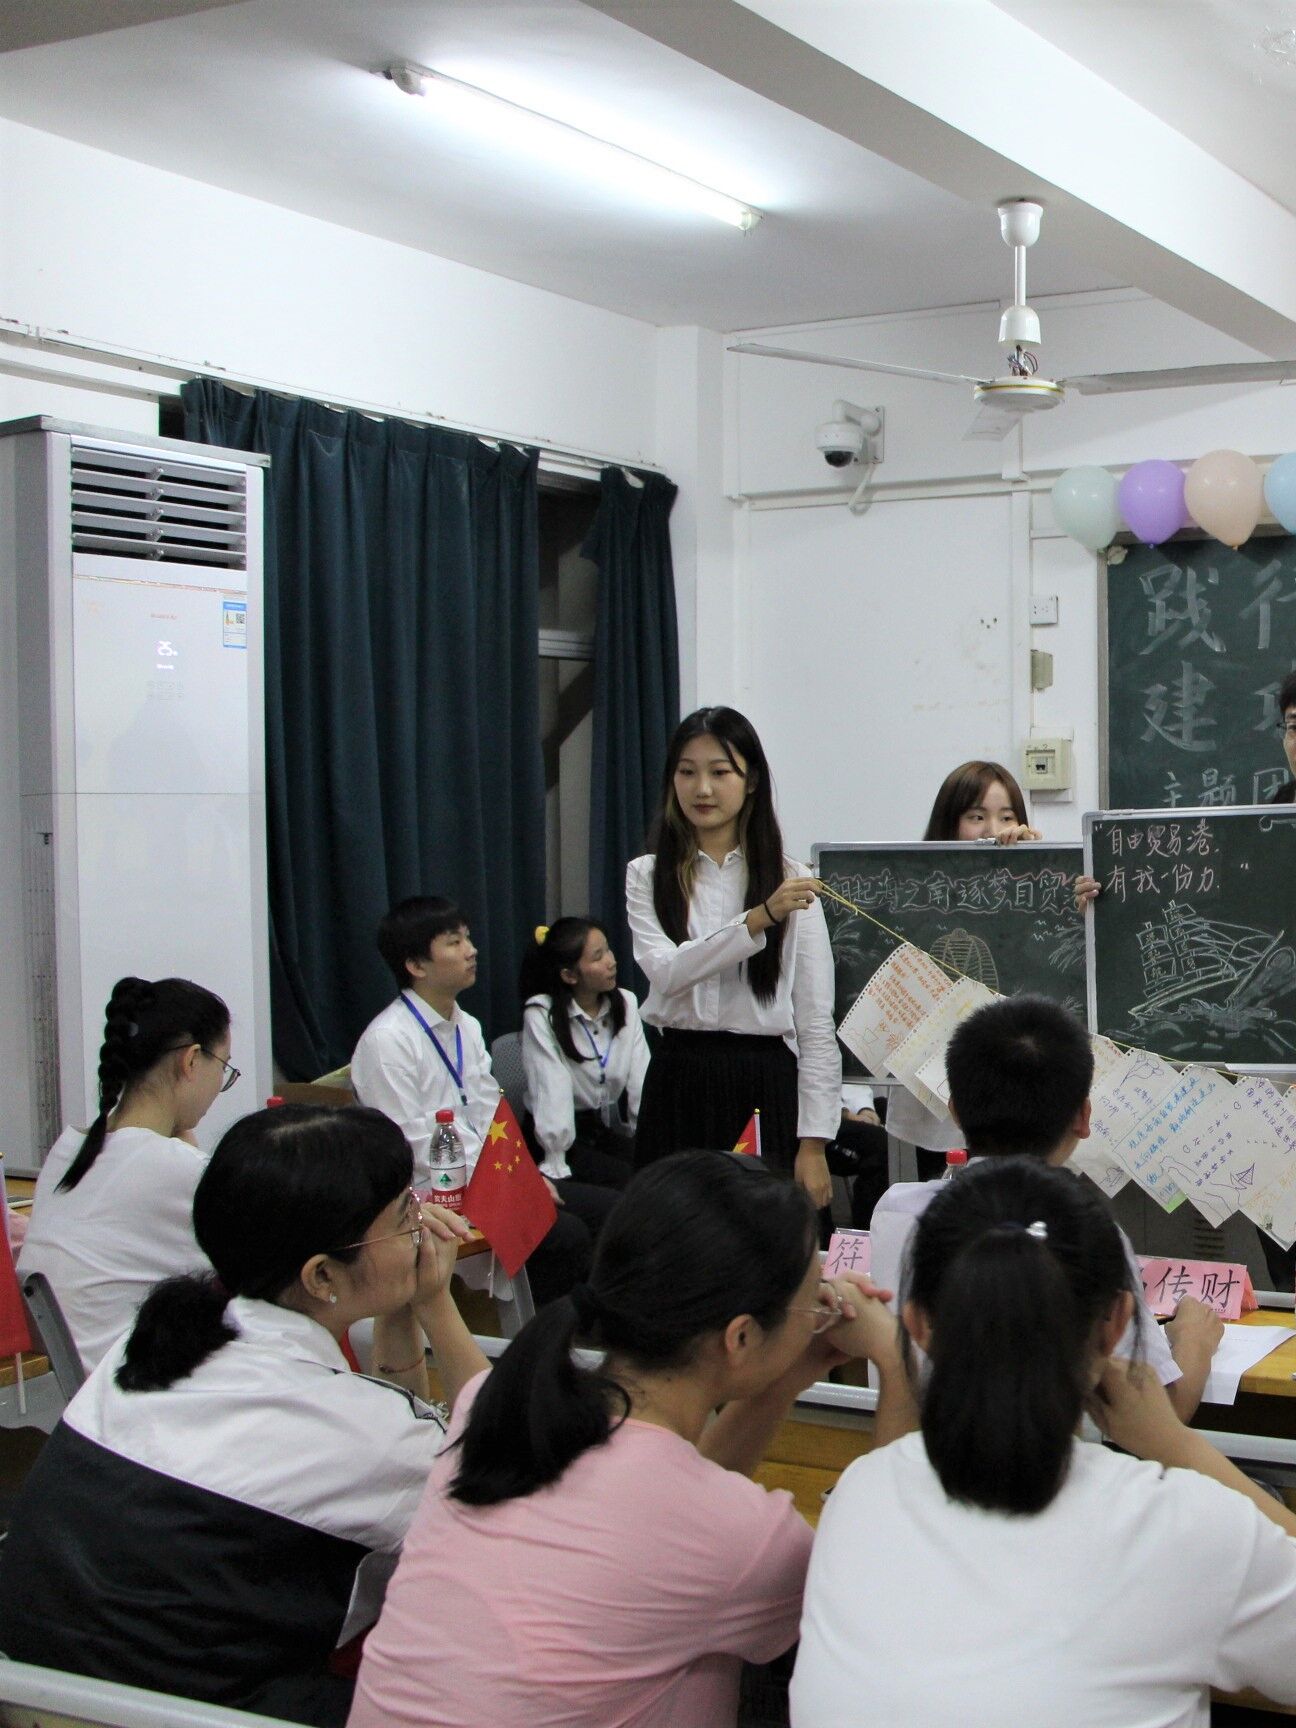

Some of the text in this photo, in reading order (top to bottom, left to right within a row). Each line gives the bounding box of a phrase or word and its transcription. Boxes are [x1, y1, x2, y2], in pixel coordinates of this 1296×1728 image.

[822, 873, 1078, 911] 潮起海之南逐梦自贸
[830, 1238, 864, 1274] 符
[1140, 1265, 1240, 1309] 传财
